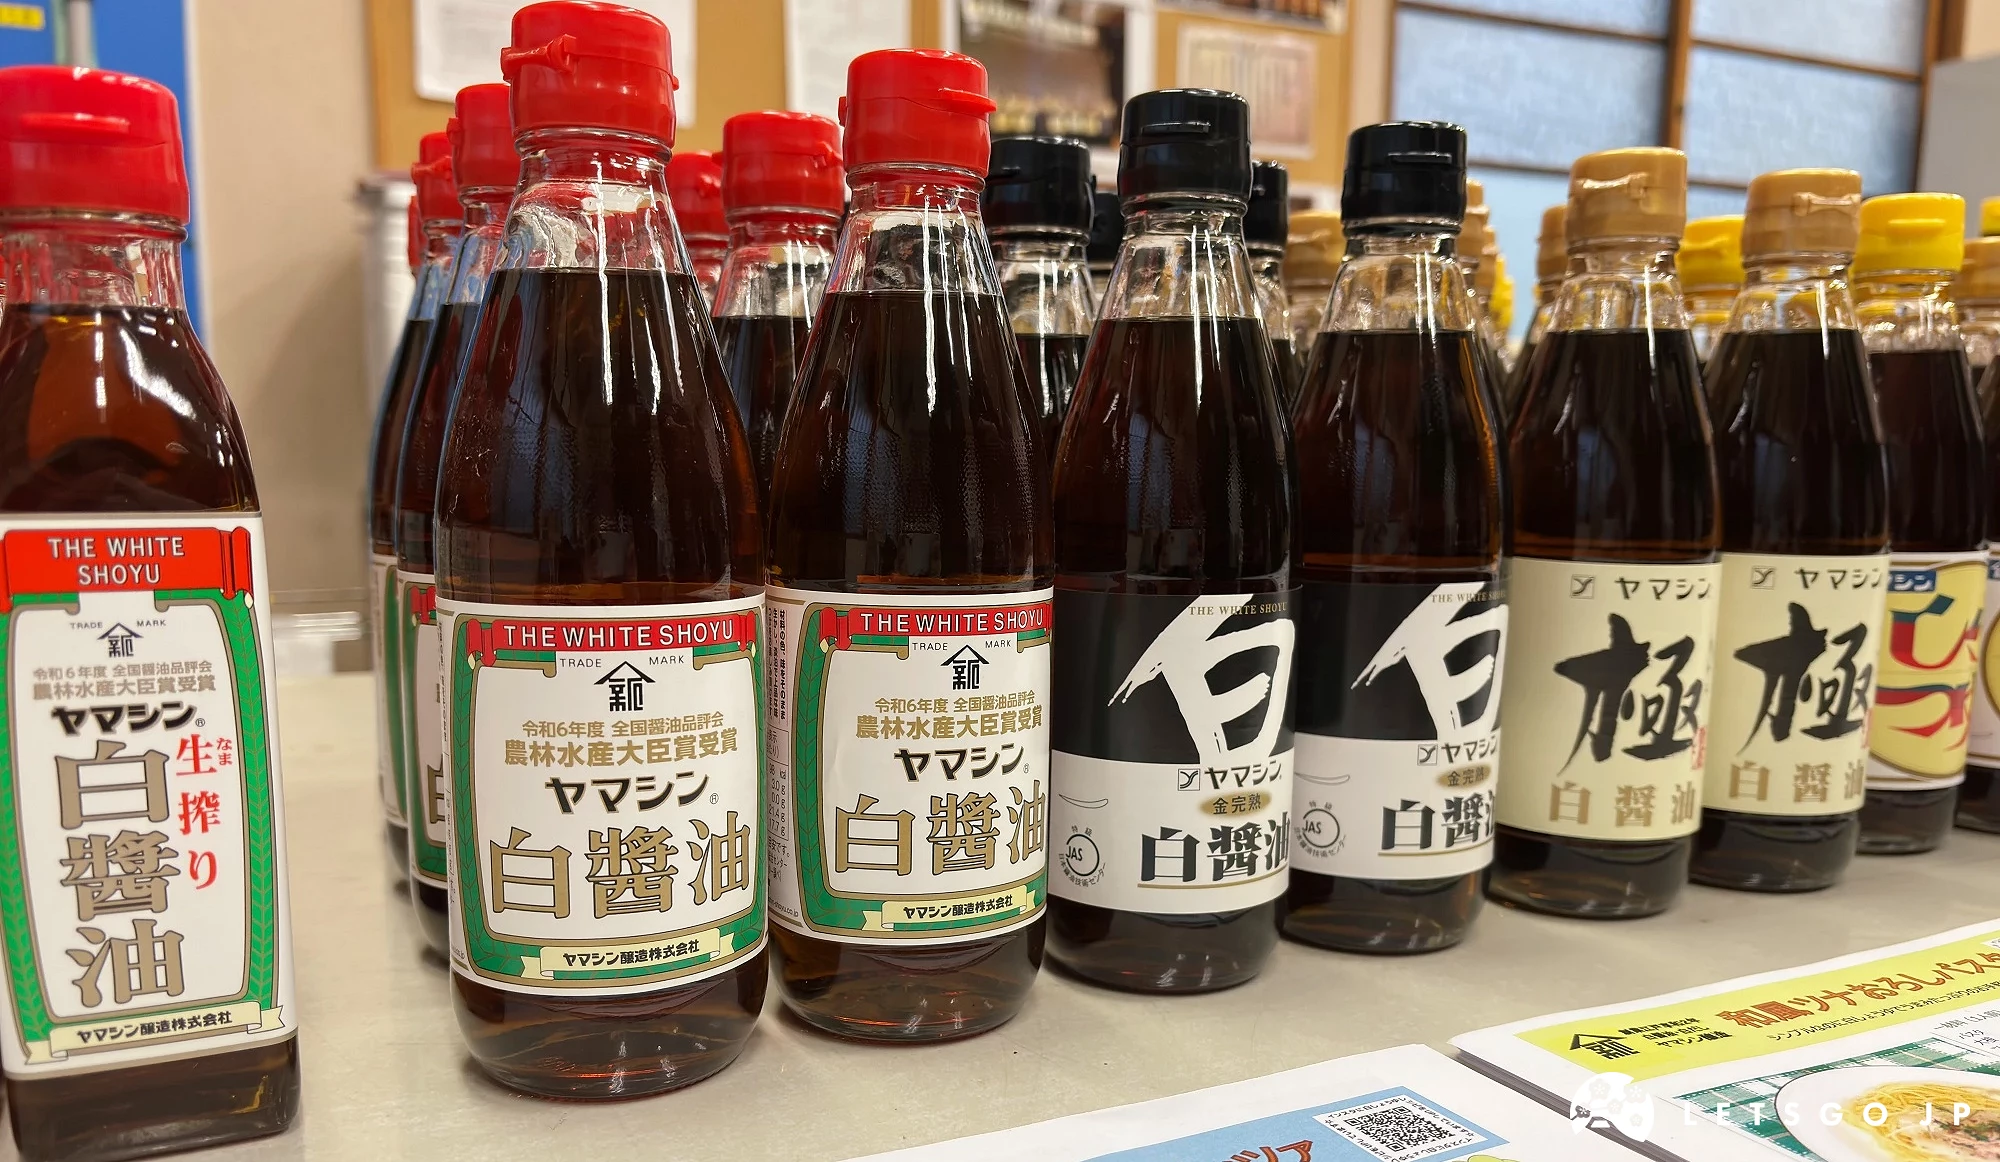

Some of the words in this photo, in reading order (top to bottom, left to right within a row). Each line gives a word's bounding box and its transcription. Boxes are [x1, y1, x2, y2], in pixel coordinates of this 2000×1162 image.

[48, 537, 96, 558] THE
[107, 536, 186, 557] WHITE
[77, 563, 162, 586] SHOYU
[1794, 568, 1882, 590] ヤマシン
[1432, 594, 1453, 604] THE
[1615, 577, 1713, 600] ヤマシン
[860, 612, 909, 634] THE
[914, 611, 988, 633] WHITE
[993, 609, 1043, 631] SHOYU
[1189, 605, 1214, 616] THE
[1220, 604, 1258, 615] WHITE
[1260, 602, 1288, 614] SHOYU
[69, 621, 103, 630] TRADE
[137, 618, 167, 628] MARK
[503, 625, 557, 649] THE
[562, 624, 652, 649] WHITE
[658, 619, 734, 645] SHOYU
[912, 641, 949, 652] TRADE
[984, 638, 1012, 649] MARK
[33, 666, 108, 681] 令和6年度
[559, 657, 602, 669] TRADE
[649, 654, 685, 666] MARK
[1350, 581, 1509, 740] 白
[33, 674, 217, 701] 農林水産大臣賞受賞
[1107, 594, 1296, 765] 白
[1733, 601, 1873, 756] 極
[874, 697, 949, 715] 令和6年度
[953, 689, 1036, 713] 全国醤油品評会
[1552, 612, 1703, 778] 極
[522, 720, 605, 738] 令和6年度
[611, 711, 724, 737] 全国醤油品評会
[855, 704, 1042, 740] 農林水産大臣賞受賞
[216, 736, 233, 766] なま
[504, 727, 738, 768] 農林水産大臣賞受賞
[1204, 759, 1281, 790] ヤマシン
[175, 733, 220, 890] 生搾り
[1212, 793, 1262, 815] 金完熟
[1302, 820, 1322, 834] JAS
[1066, 845, 1083, 862] JAS
[903, 894, 1014, 920] ヤマシン醸造株式会社
[563, 939, 700, 967] ヤマシン醸造株式会社
[77, 1009, 233, 1045] ヤマシン醸造株式会社
